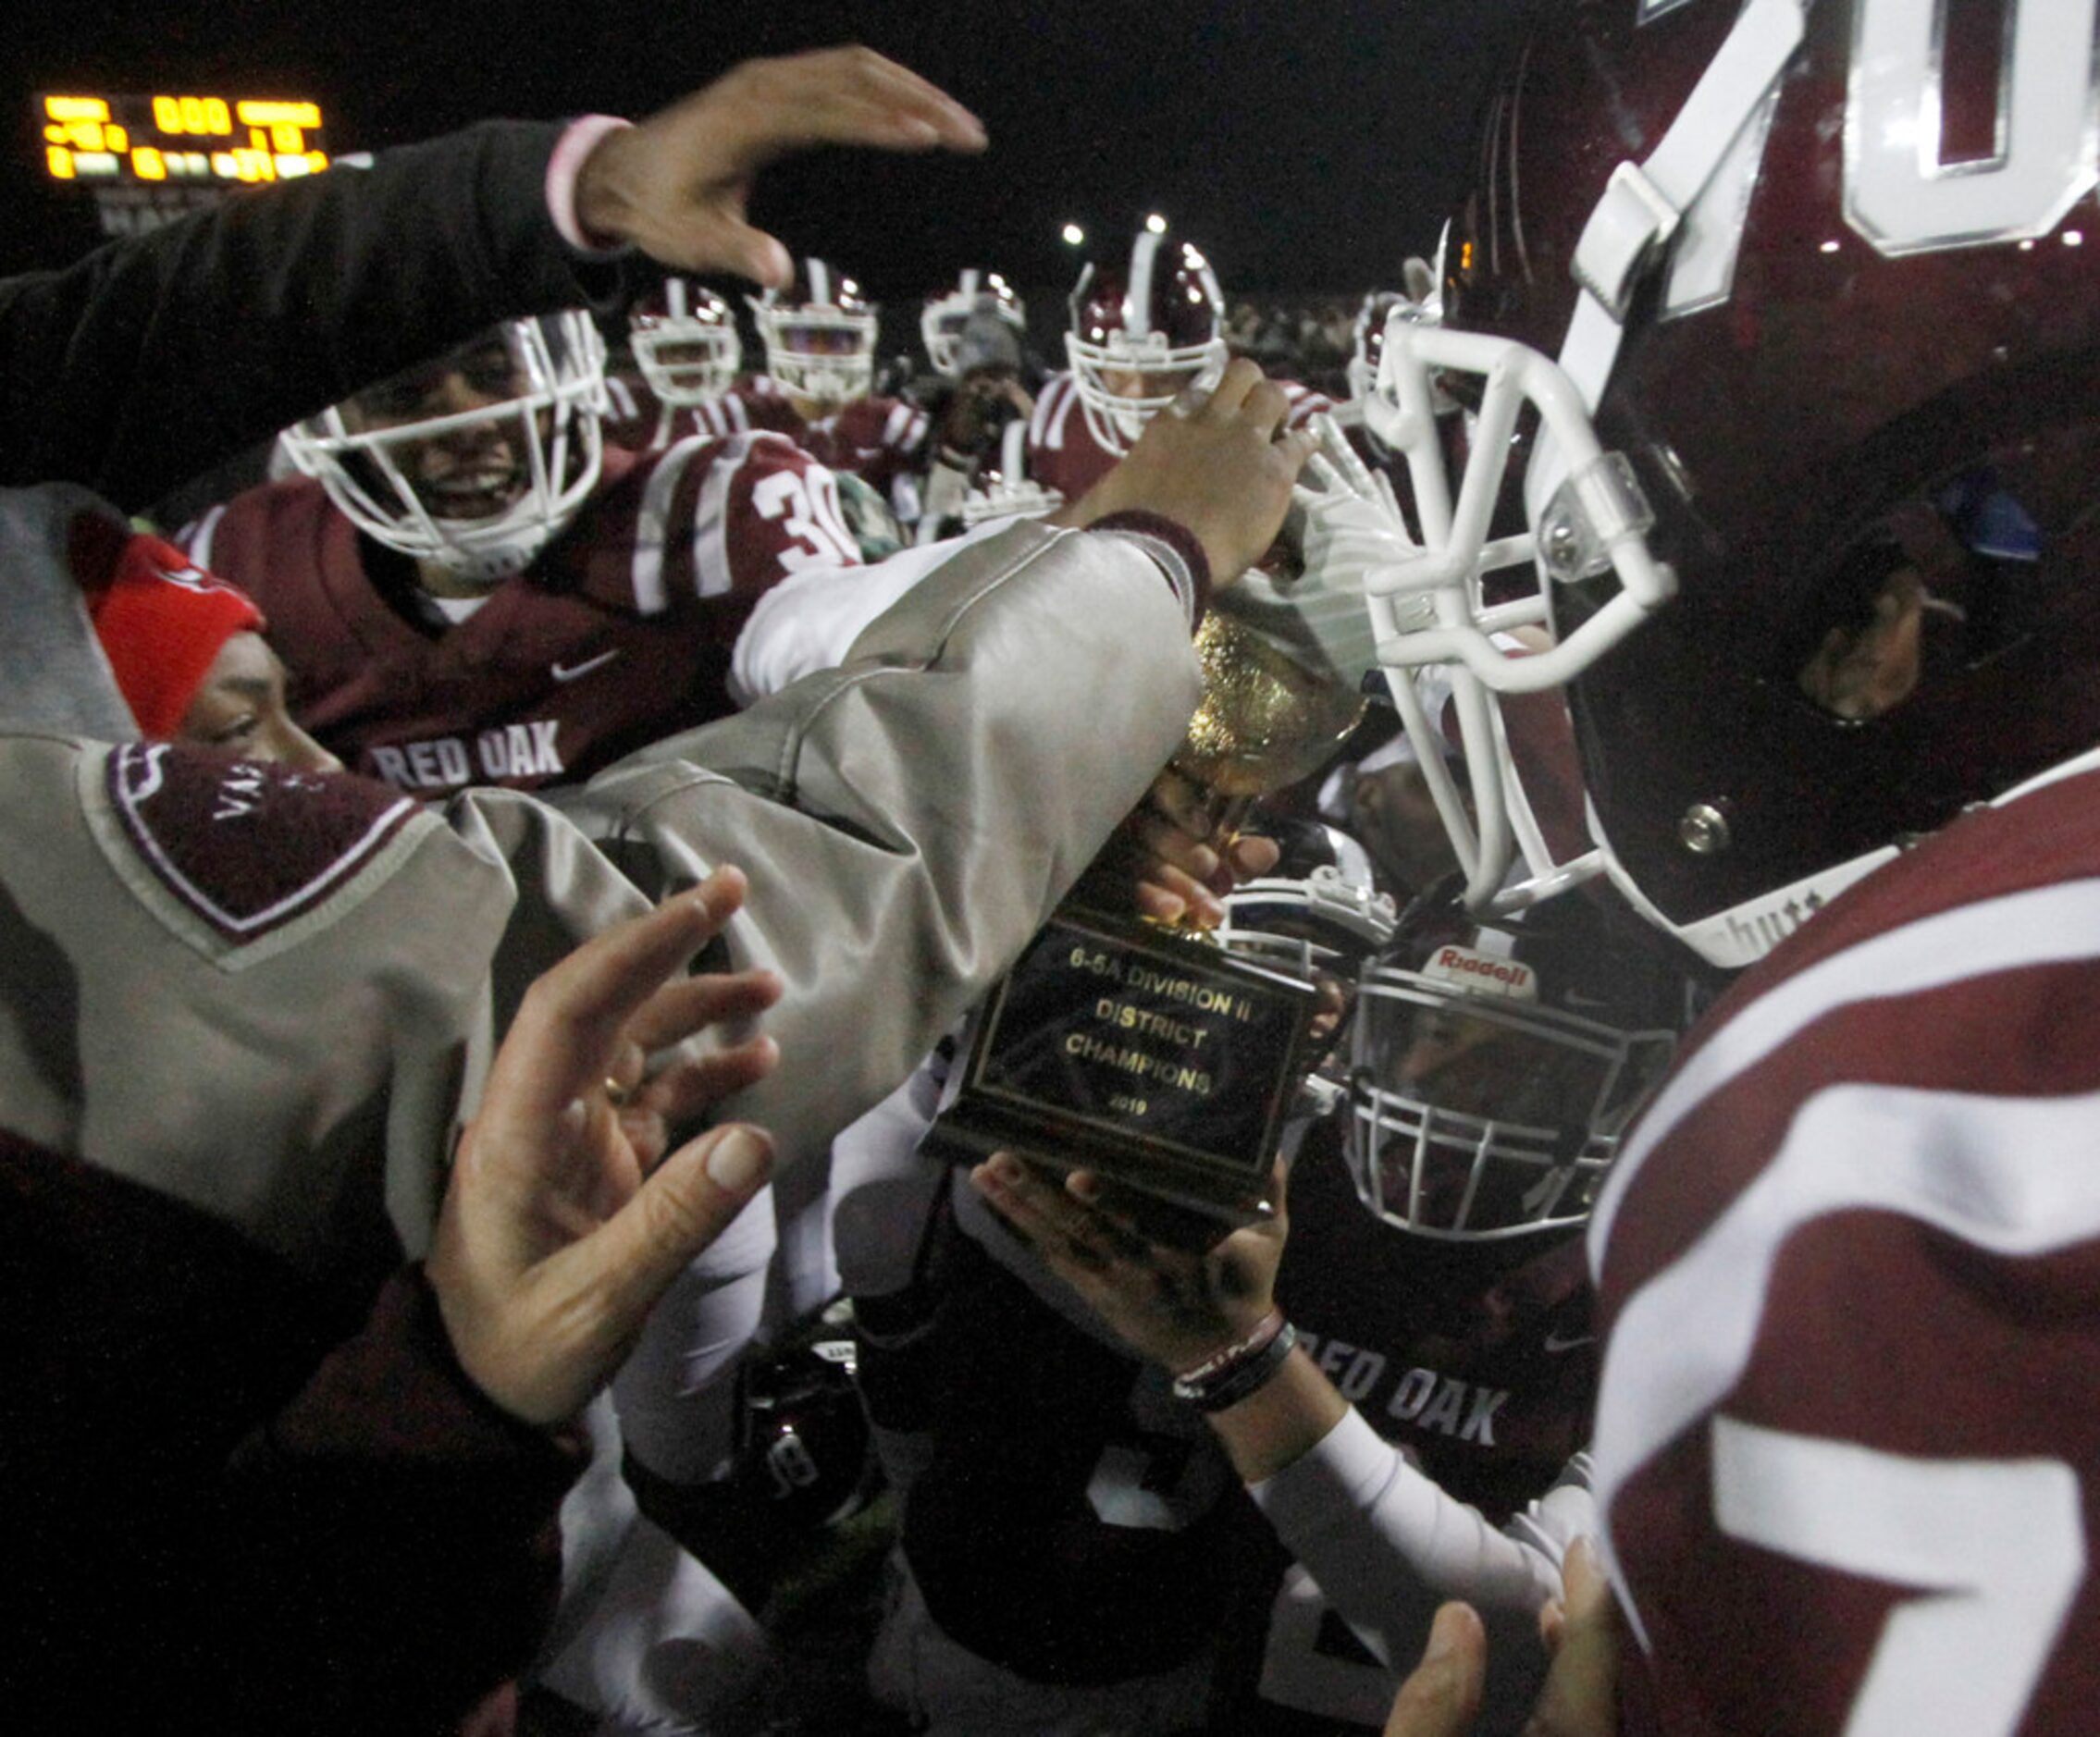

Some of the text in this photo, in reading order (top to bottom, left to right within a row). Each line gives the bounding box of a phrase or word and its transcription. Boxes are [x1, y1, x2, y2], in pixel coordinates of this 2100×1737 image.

[751, 462, 864, 573] 30
[372, 720, 564, 788] RED OAK
[1713, 889, 1822, 951] hutt
[1069, 946, 1252, 1022] 6-5A DIVISION II
[1095, 998, 1208, 1049] DISTRICT
[1065, 1032, 1212, 1095] CHAMPIONS
[1109, 1093, 1148, 1116] 2019
[1388, 1367, 1509, 1447] OAK
[1711, 1413, 2088, 1737] 7
